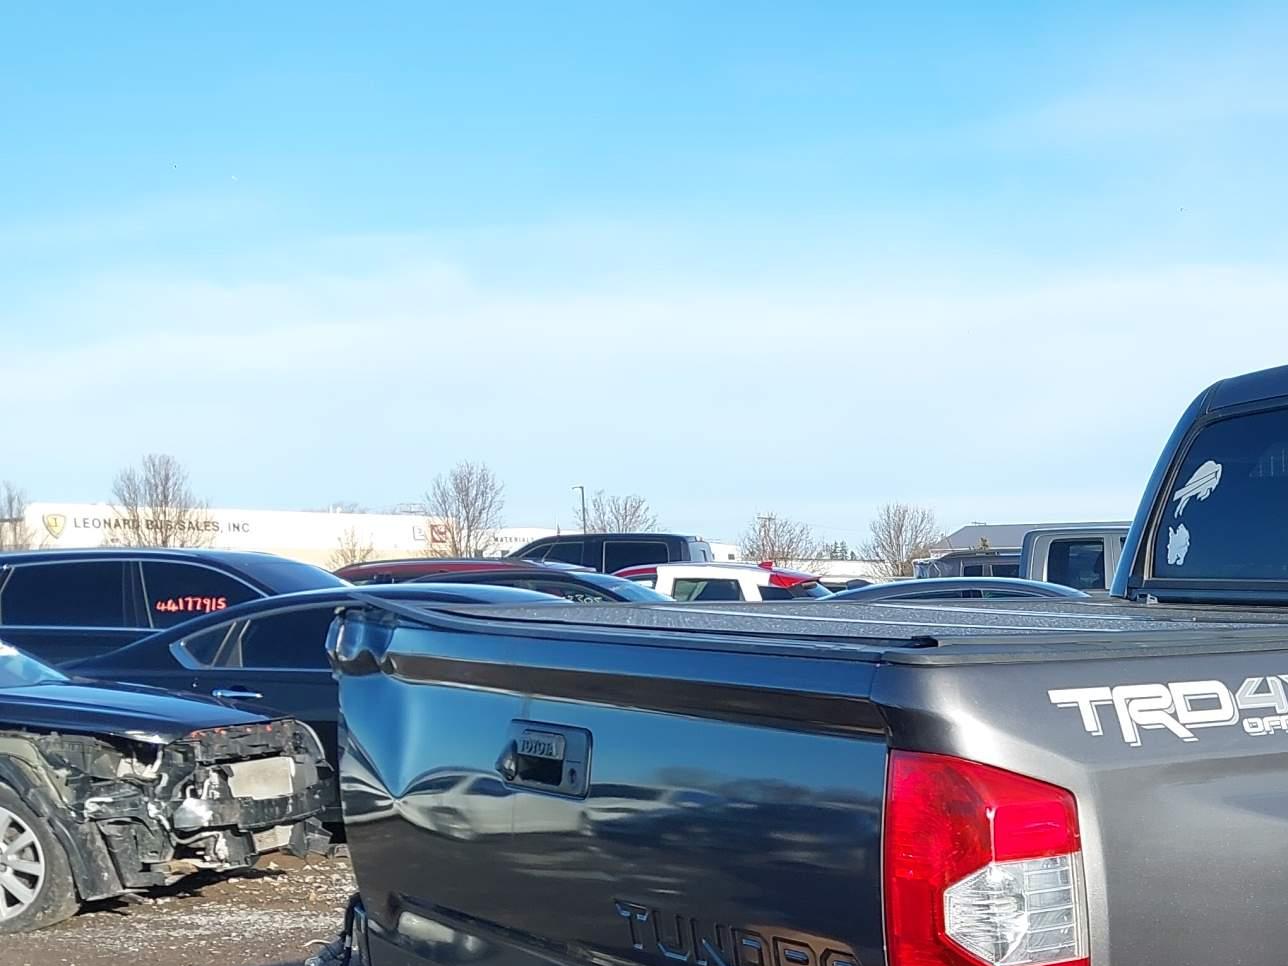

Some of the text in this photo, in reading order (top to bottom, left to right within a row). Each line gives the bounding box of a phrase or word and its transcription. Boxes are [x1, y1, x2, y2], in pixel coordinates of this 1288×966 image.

[73, 517, 140, 530] LEONARD
[145, 519, 174, 531] BUS
[228, 522, 250, 533] INC
[1047, 680, 1240, 747] TRD
[520, 738, 558, 757] TOYOTA
